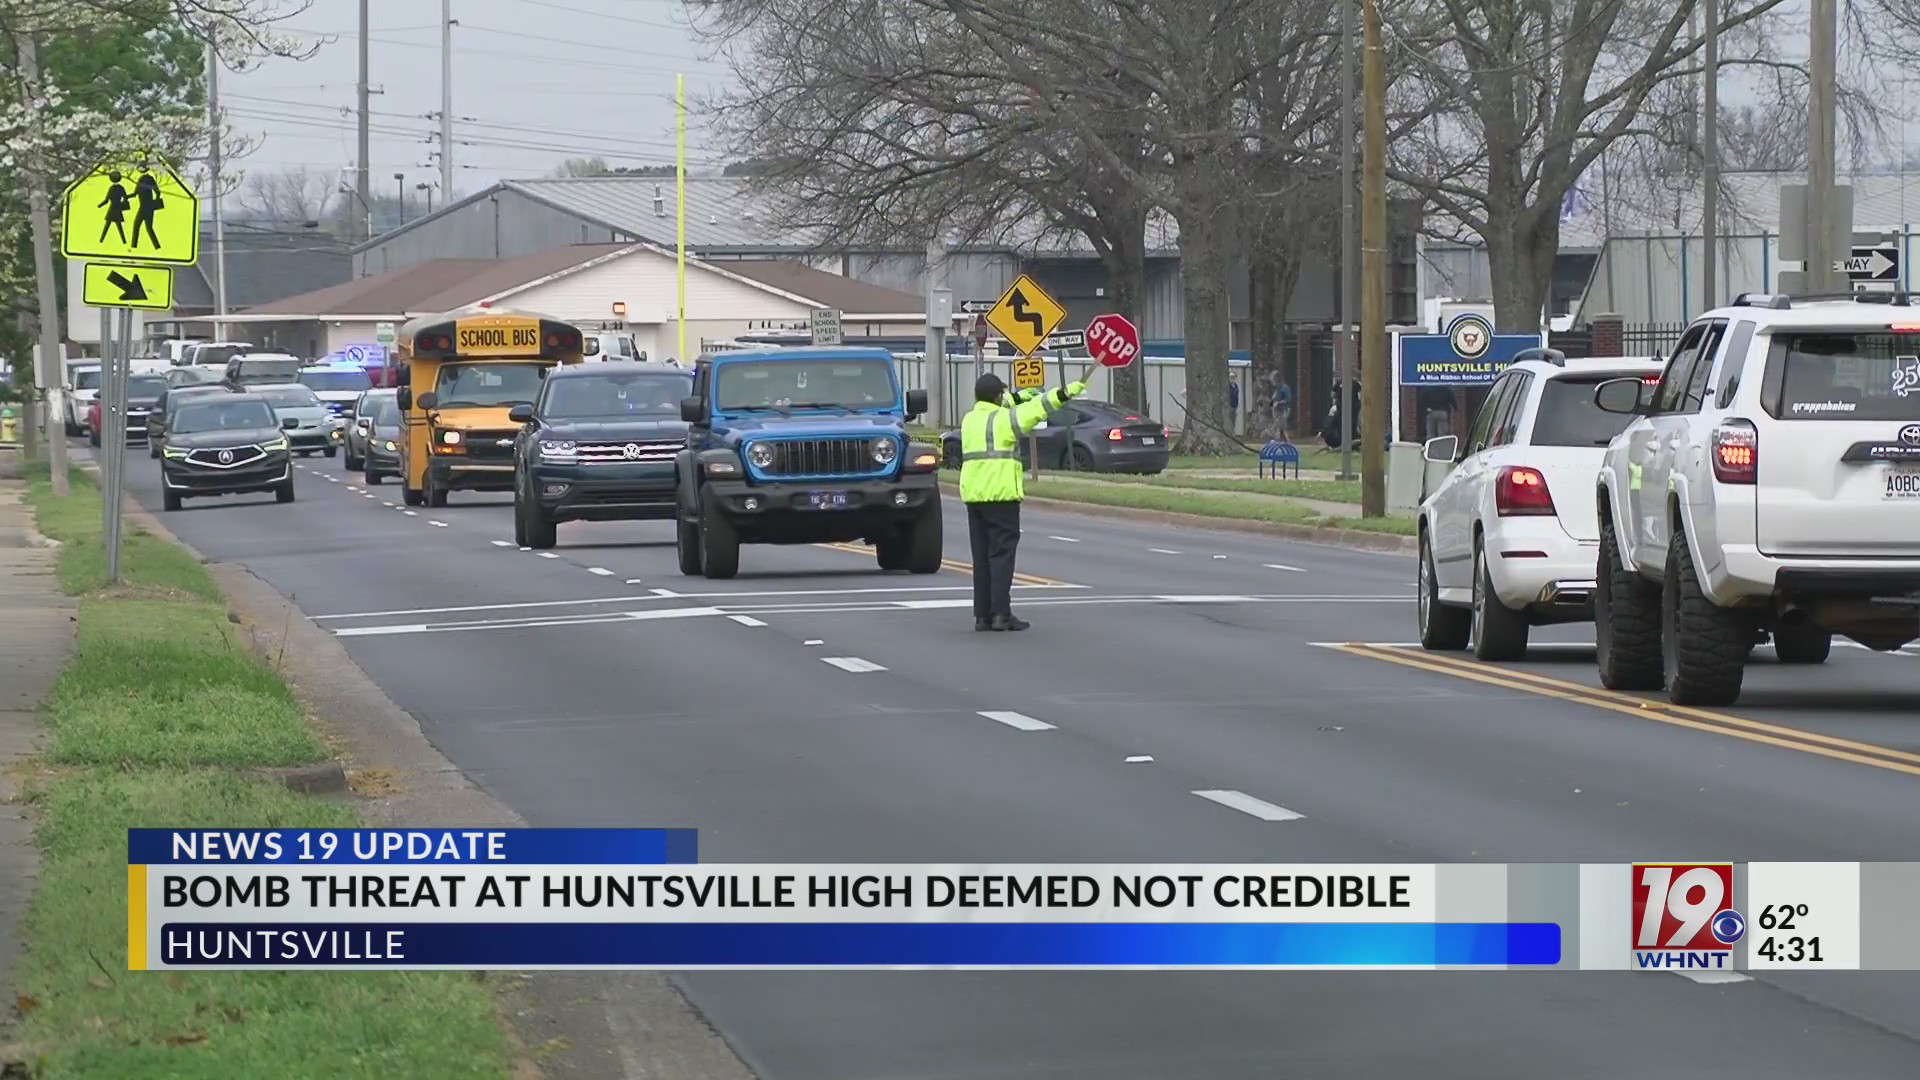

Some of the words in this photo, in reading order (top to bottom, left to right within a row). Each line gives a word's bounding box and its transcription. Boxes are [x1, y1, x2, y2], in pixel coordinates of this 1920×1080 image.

[1844, 258, 1870, 271] WAY
[461, 330, 507, 347] SCHOOL
[513, 329, 536, 346] BUS
[818, 335, 835, 343] LIMIT
[1065, 336, 1079, 344] WAY
[1089, 321, 1135, 360] STOP
[1016, 361, 1041, 377] 25
[1417, 363, 1491, 372] HUNTSVILLE
[1892, 363, 1920, 390] 25
